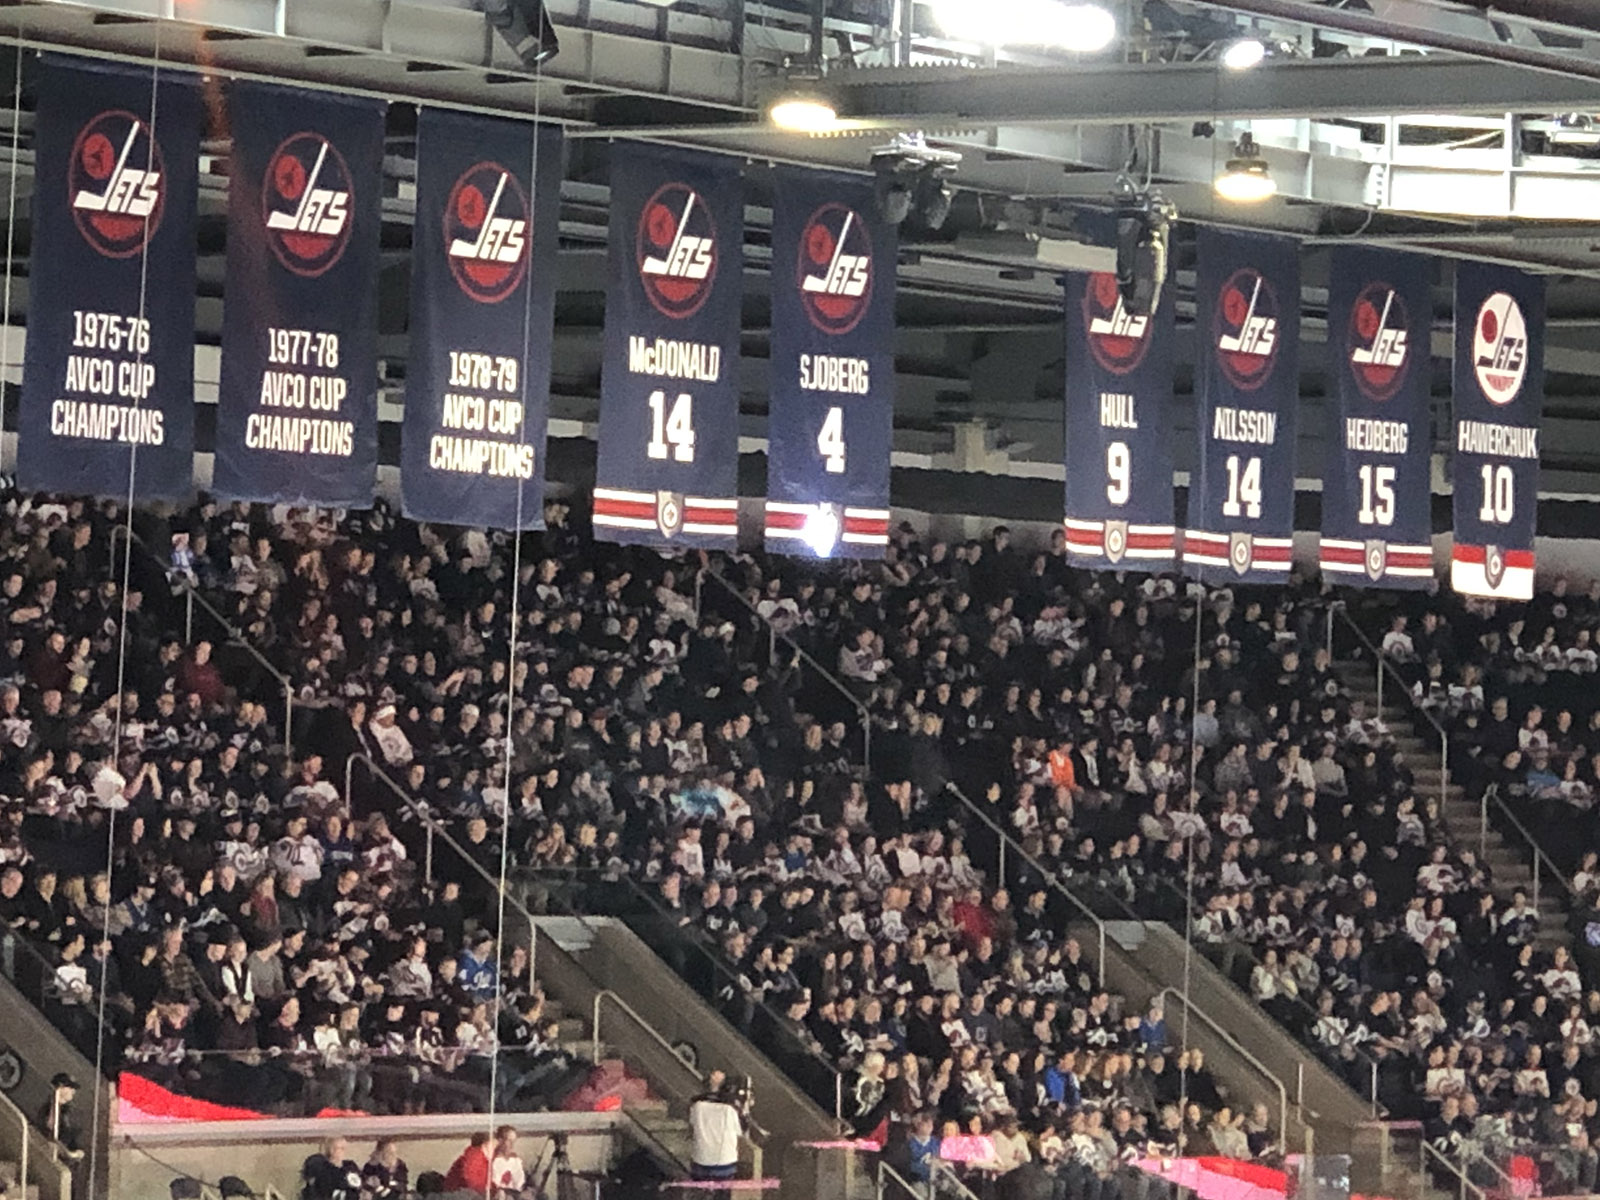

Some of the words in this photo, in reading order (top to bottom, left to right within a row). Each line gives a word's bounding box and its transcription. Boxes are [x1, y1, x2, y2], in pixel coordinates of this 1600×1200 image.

[73, 120, 161, 217] JETS
[266, 142, 349, 235] JETS
[449, 172, 526, 263] JETS
[642, 192, 714, 280] JETS
[802, 211, 870, 297] JETS
[72, 310, 150, 354] 1975-76
[1219, 276, 1276, 356] JETS
[268, 327, 338, 368] 1977-78
[629, 336, 720, 382] McDONALD
[65, 355, 114, 395] AVCO
[118, 361, 155, 399] CUP
[260, 370, 305, 409] AVCO
[309, 376, 347, 412] CUP
[449, 351, 517, 393] 1978-79
[800, 354, 868, 394] SJOBERG
[51, 399, 164, 446] CHAMPIONS
[442, 393, 485, 432] AVCO
[487, 400, 522, 435] CUP
[647, 390, 695, 462] 14
[1100, 393, 1138, 429] HULL
[1213, 406, 1277, 445] NILSSON
[245, 413, 354, 457] CHAMPIONS
[429, 435, 535, 480] CHAMPIONS
[817, 406, 845, 474] 4
[1346, 417, 1409, 454] HEDBERG
[1457, 420, 1539, 459] HAWERCHUK
[1107, 441, 1132, 506] 9
[1222, 455, 1262, 519] 14
[1358, 464, 1396, 526] 15
[1479, 464, 1514, 524] 10
